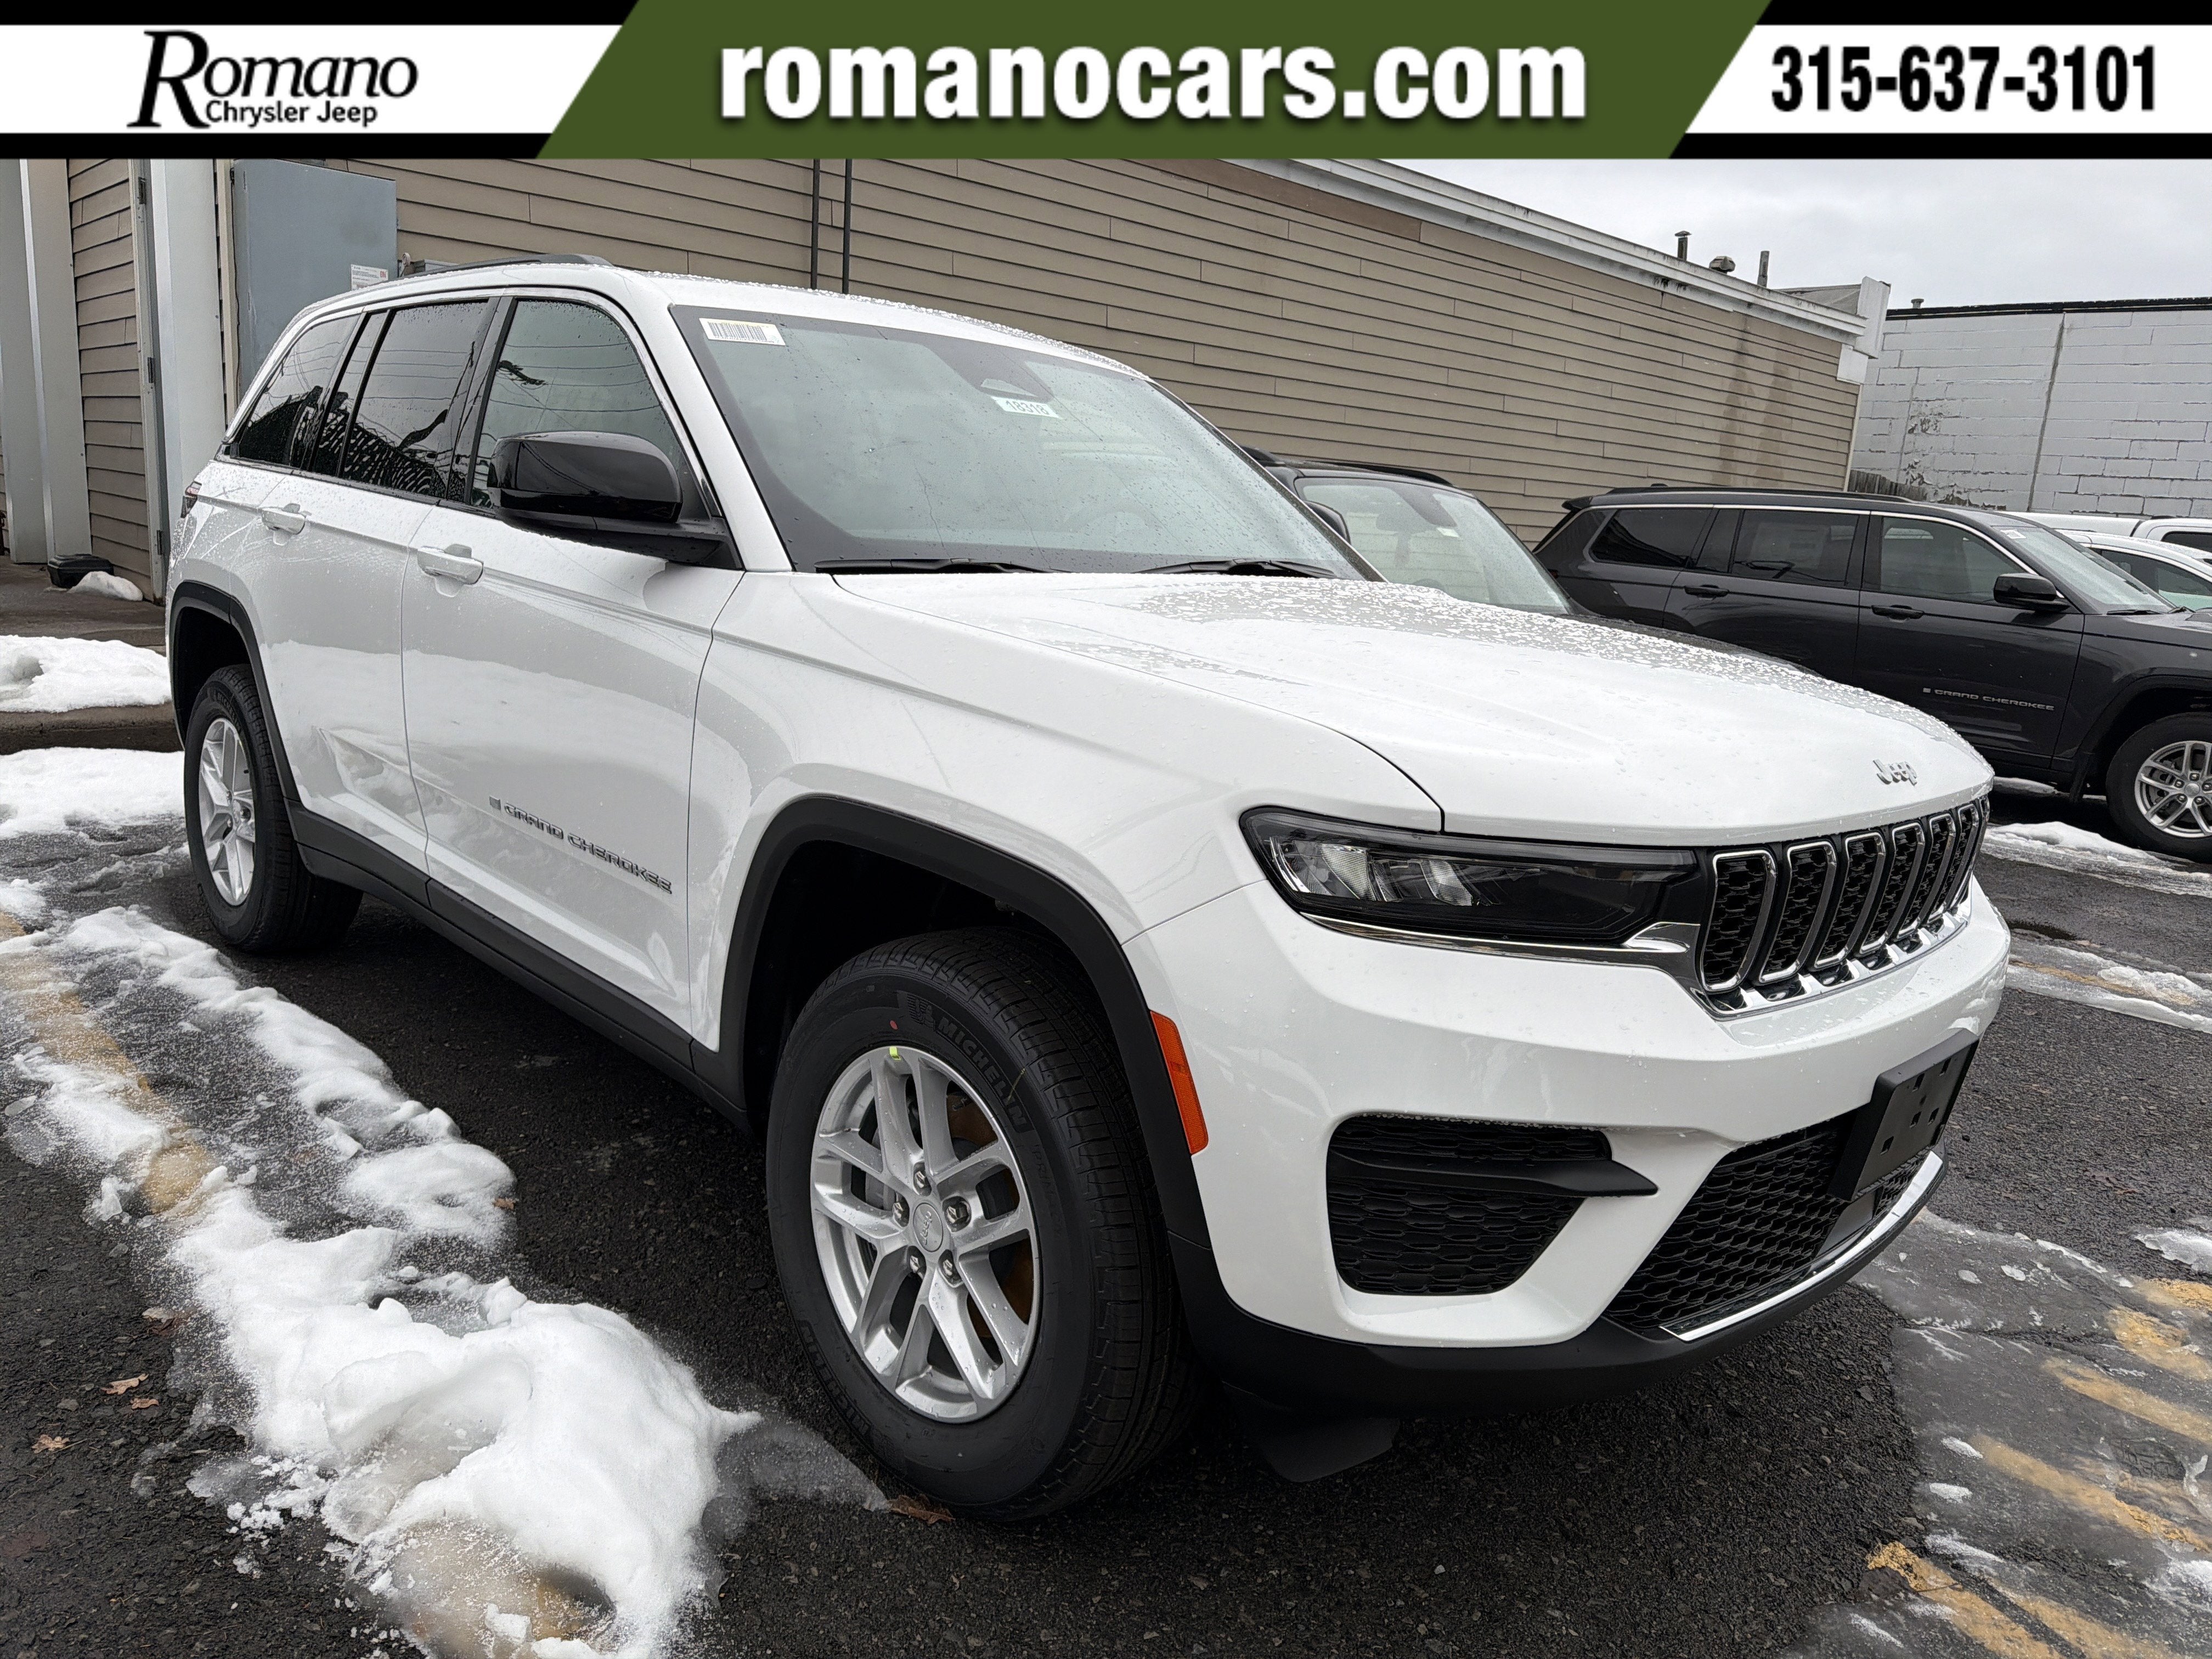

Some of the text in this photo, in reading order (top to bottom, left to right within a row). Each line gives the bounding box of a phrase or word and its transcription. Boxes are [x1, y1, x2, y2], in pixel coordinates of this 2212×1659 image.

[1006, 400, 1049, 415] 18318
[1934, 689, 2055, 711] GRAND CHEROKEE
[1872, 759, 1918, 787] Jeep
[504, 802, 673, 894] GRAND CHEROKEE
[938, 1016, 1029, 1125] MICHELIN
